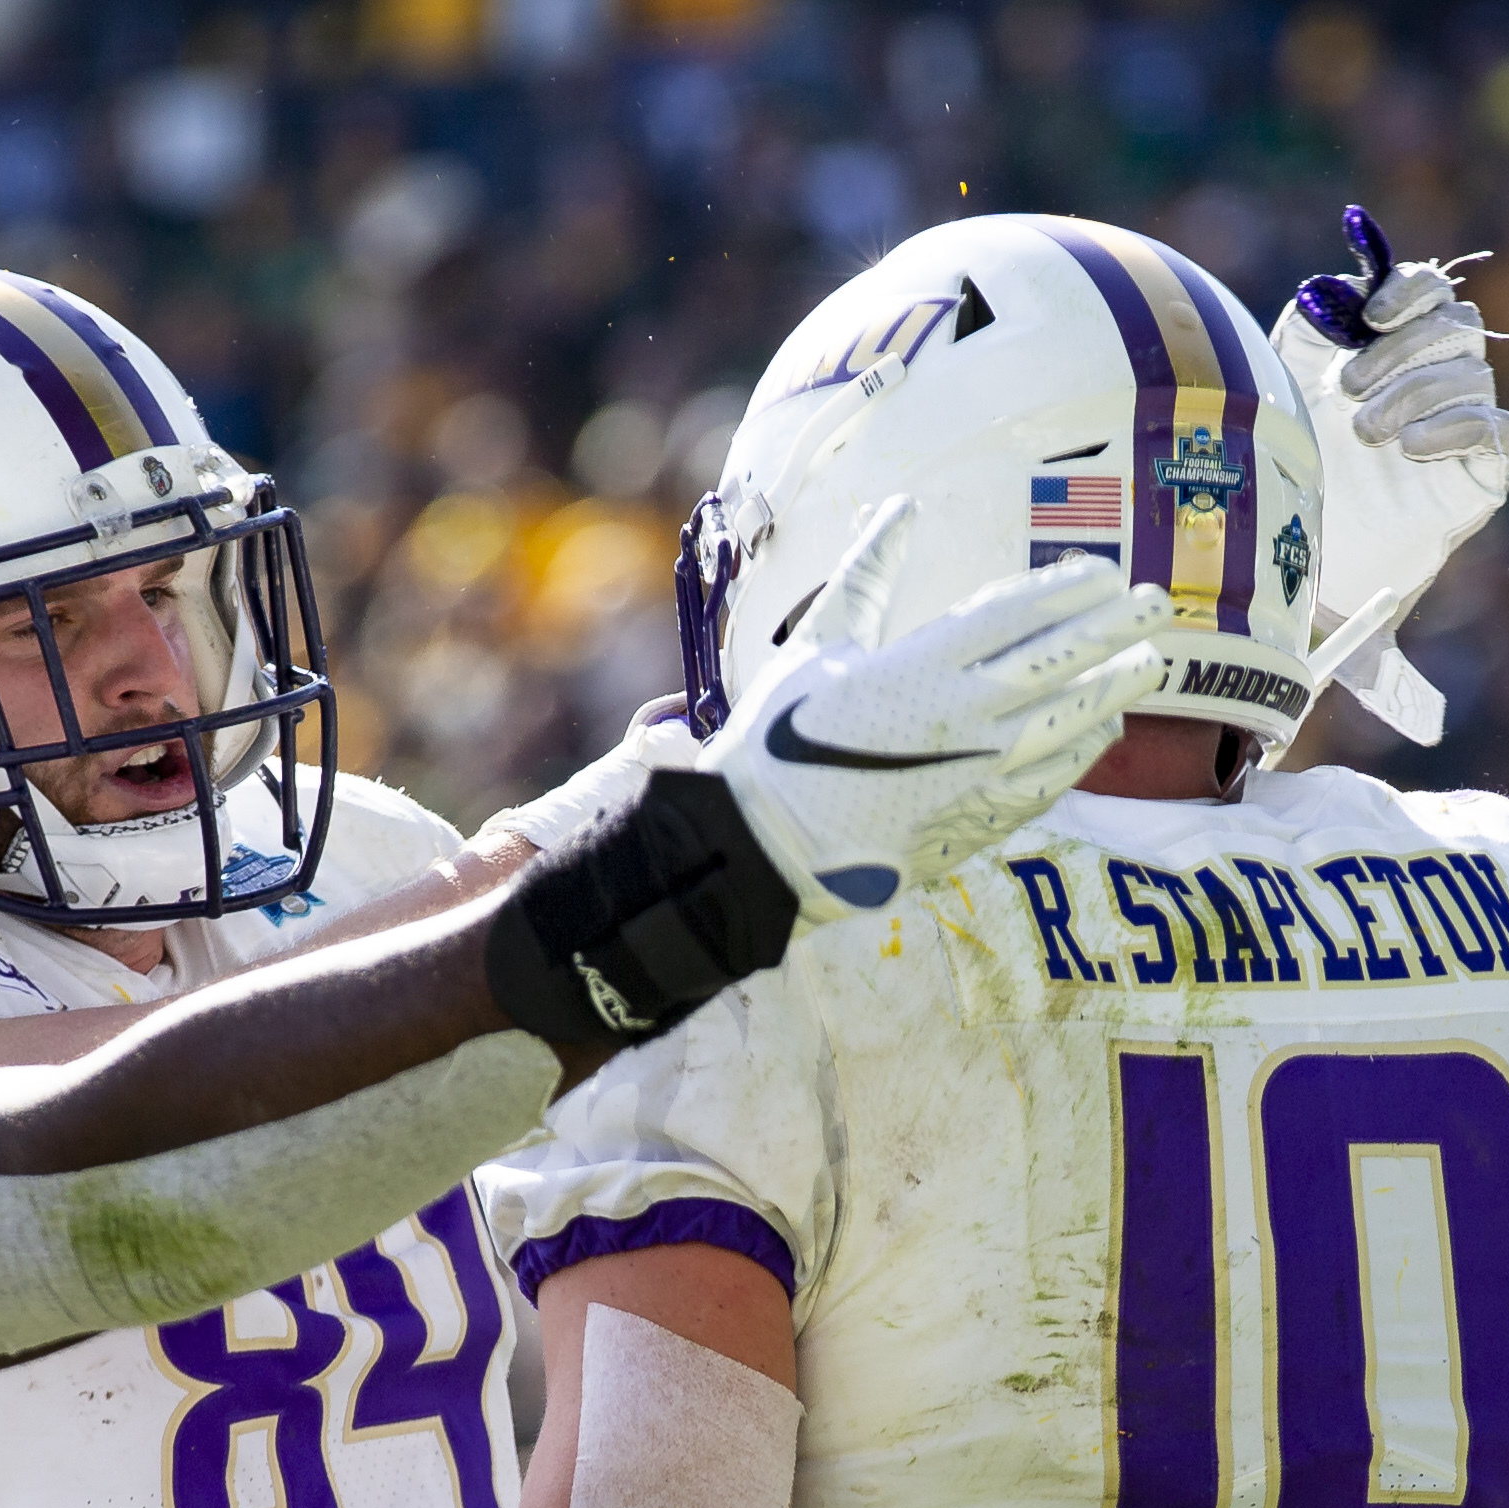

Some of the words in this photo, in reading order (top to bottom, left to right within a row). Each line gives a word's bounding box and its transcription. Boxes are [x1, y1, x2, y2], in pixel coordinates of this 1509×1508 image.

[1183, 458, 1222, 470] FOOTBALL
[1165, 466, 1241, 486] CHAMPIONSHIP
[1278, 541, 1307, 567] FCS
